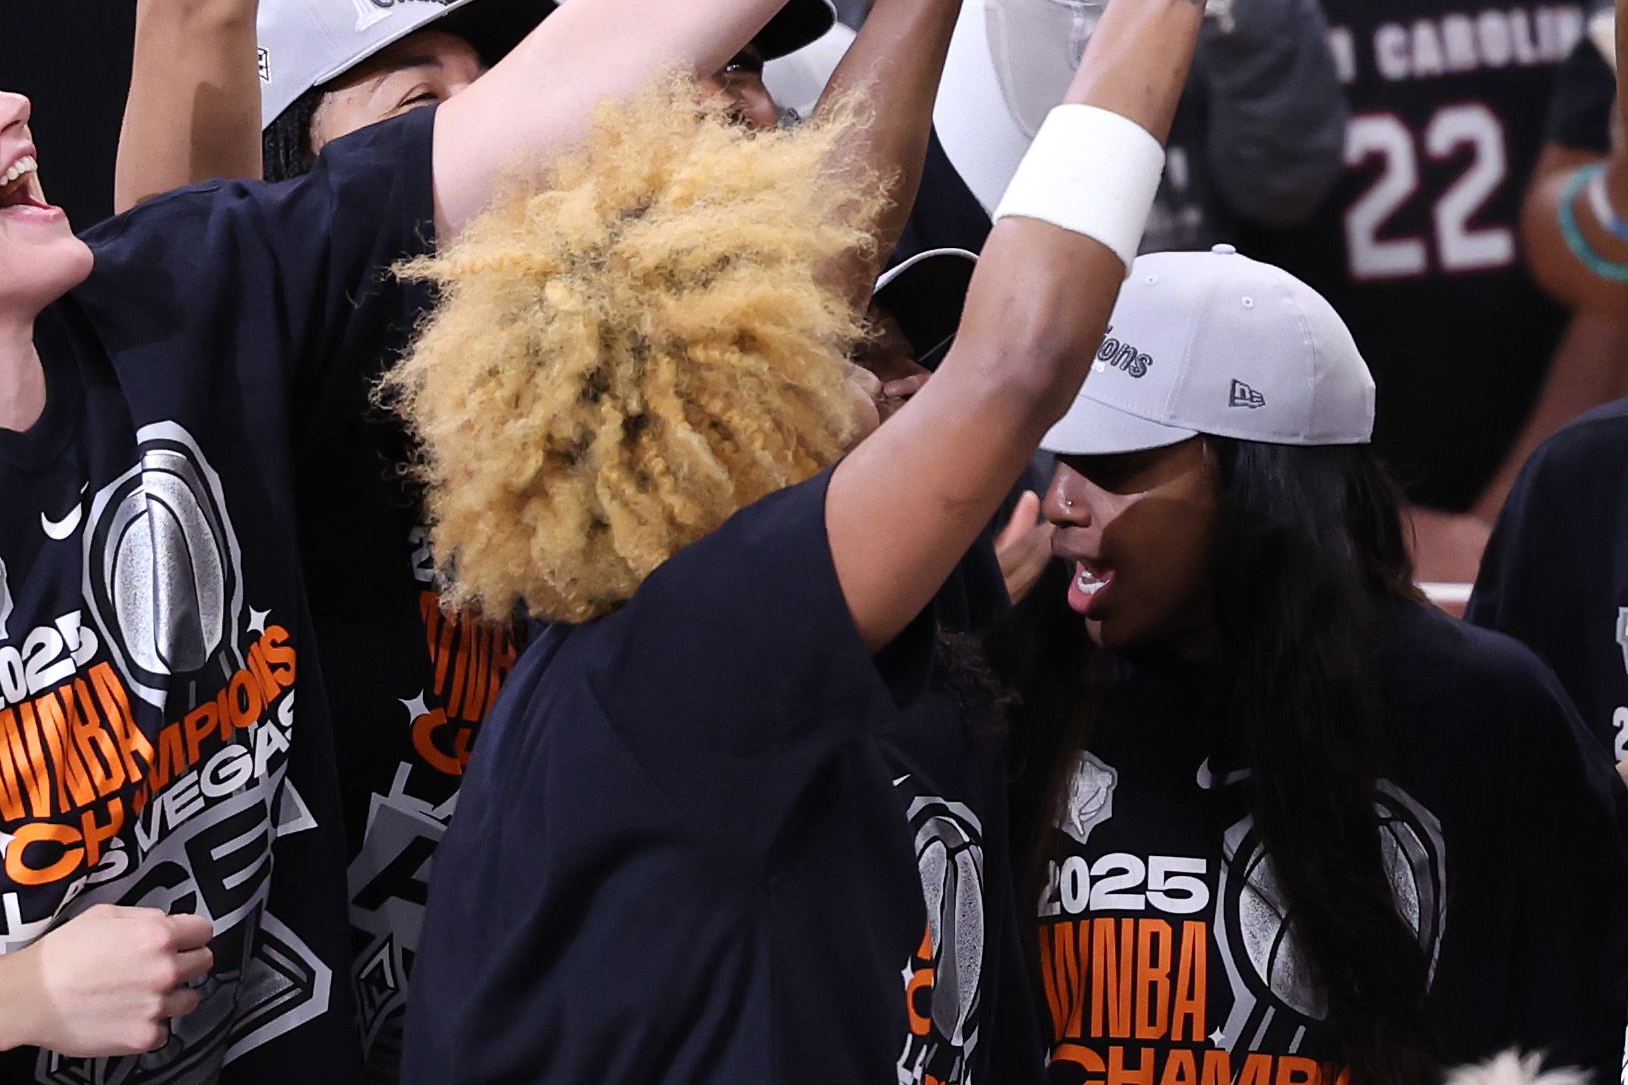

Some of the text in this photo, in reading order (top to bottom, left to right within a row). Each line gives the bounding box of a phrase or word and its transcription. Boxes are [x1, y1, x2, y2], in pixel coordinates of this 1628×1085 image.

[1344, 103, 1515, 281] 22
[0, 610, 98, 709] 025
[1039, 917, 1208, 1043] WNBA
